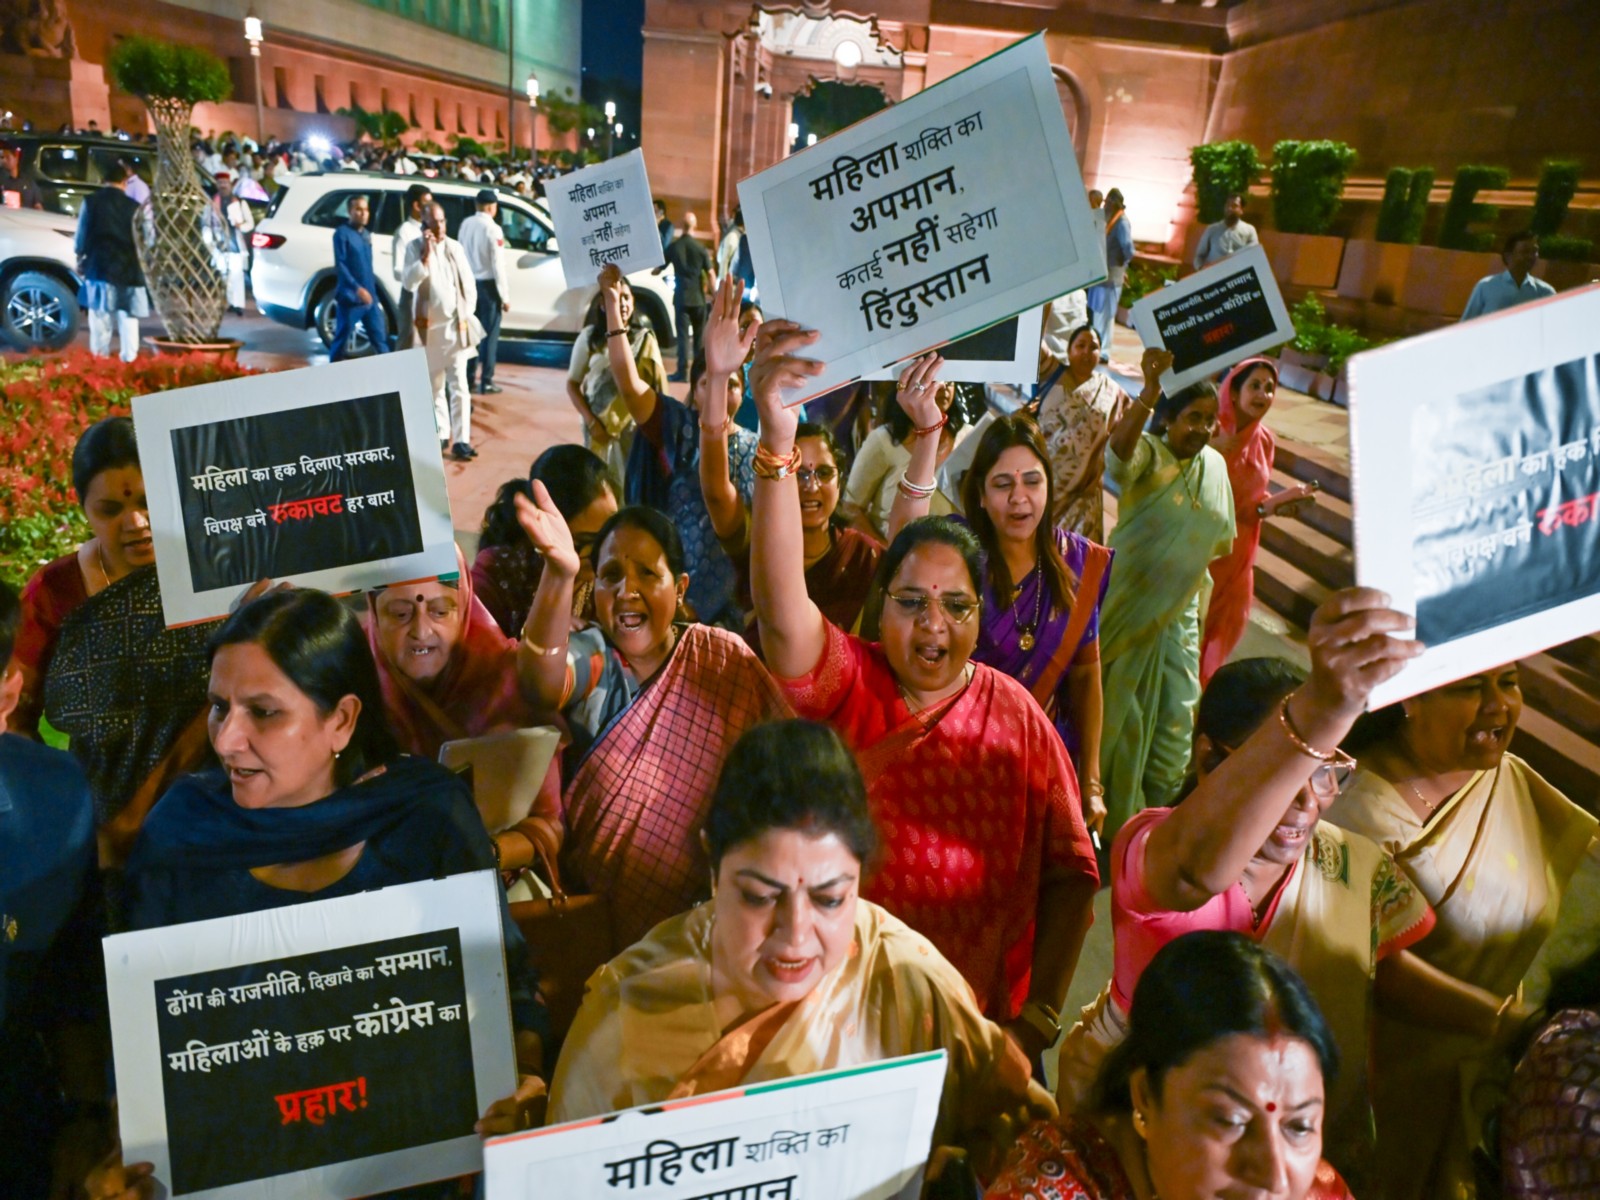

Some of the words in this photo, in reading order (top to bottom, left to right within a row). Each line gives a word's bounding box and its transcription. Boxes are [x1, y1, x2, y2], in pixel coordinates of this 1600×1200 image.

[808, 141, 900, 201] महिला
[902, 127, 954, 162] शक्ति
[954, 110, 983, 138] का
[568, 183, 597, 203] महिला
[850, 165, 965, 233] अपमान,
[836, 250, 885, 290] कतई
[882, 215, 941, 266] नहीं
[943, 207, 999, 244] सहेगा
[860, 253, 992, 332] हिंदुस्तान
[190, 465, 249, 493] महिला
[251, 467, 270, 483] का
[272, 464, 297, 481] हक
[299, 454, 344, 476] दिलाए
[343, 446, 396, 467] सरकार,
[203, 517, 243, 537] विपक्ष
[246, 508, 268, 529] बने
[267, 493, 345, 525] रुकावट
[345, 495, 364, 513] हर
[365, 489, 396, 508] बार!
[165, 989, 203, 1017] ढोंग
[206, 988, 226, 1008] की
[228, 970, 306, 1004] राजनीति,
[308, 966, 353, 991] दिखावे
[356, 966, 374, 981] का
[375, 945, 453, 978] सम्मान,
[167, 1028, 270, 1074] महिलाओं
[273, 1031, 293, 1053] के
[328, 1025, 352, 1043] पर
[353, 997, 435, 1039] कांग्रेस
[437, 1004, 461, 1022] का
[274, 1076, 369, 1127] प्रहार!
[604, 1136, 740, 1190] महिला
[744, 1130, 812, 1163] शक्ति
[816, 1123, 851, 1149] का
